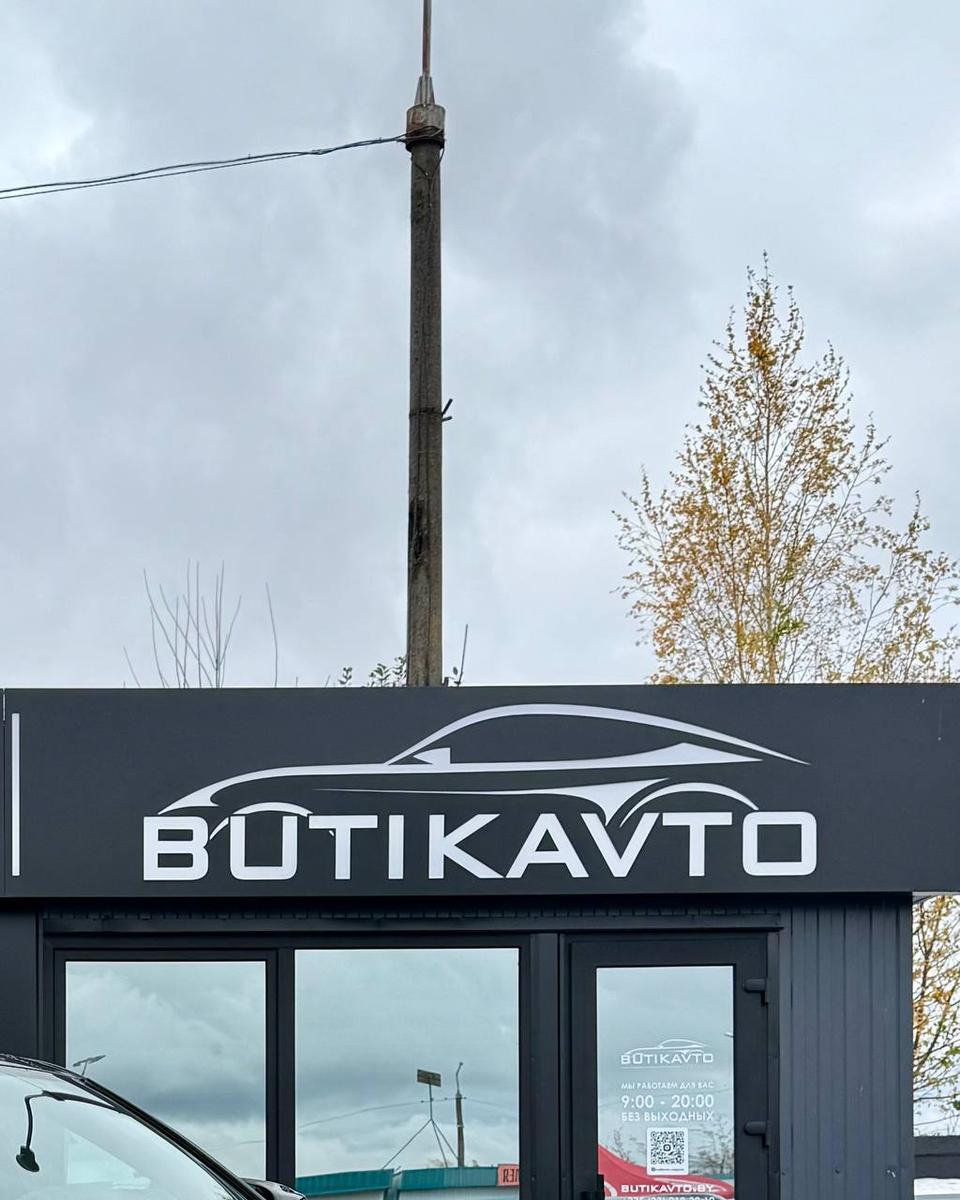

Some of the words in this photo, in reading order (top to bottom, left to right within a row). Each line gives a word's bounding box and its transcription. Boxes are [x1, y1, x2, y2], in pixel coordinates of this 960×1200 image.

[143, 811, 818, 881] BUTIKAVTO
[620, 1053, 715, 1065] BUTIKAVTO
[621, 1082, 635, 1090] МЫ
[637, 1082, 678, 1090] РАБОТАЕМ
[680, 1082, 696, 1090] ДЛЯ
[698, 1081, 715, 1089] ВАС
[621, 1095, 655, 1109] 9:00
[671, 1094, 714, 1108] 20:00
[621, 1111, 641, 1122] БЕЗ
[644, 1111, 715, 1122] ВЫХОДНЫХ
[621, 1184, 714, 1193] BUTIKAVTO.BY
